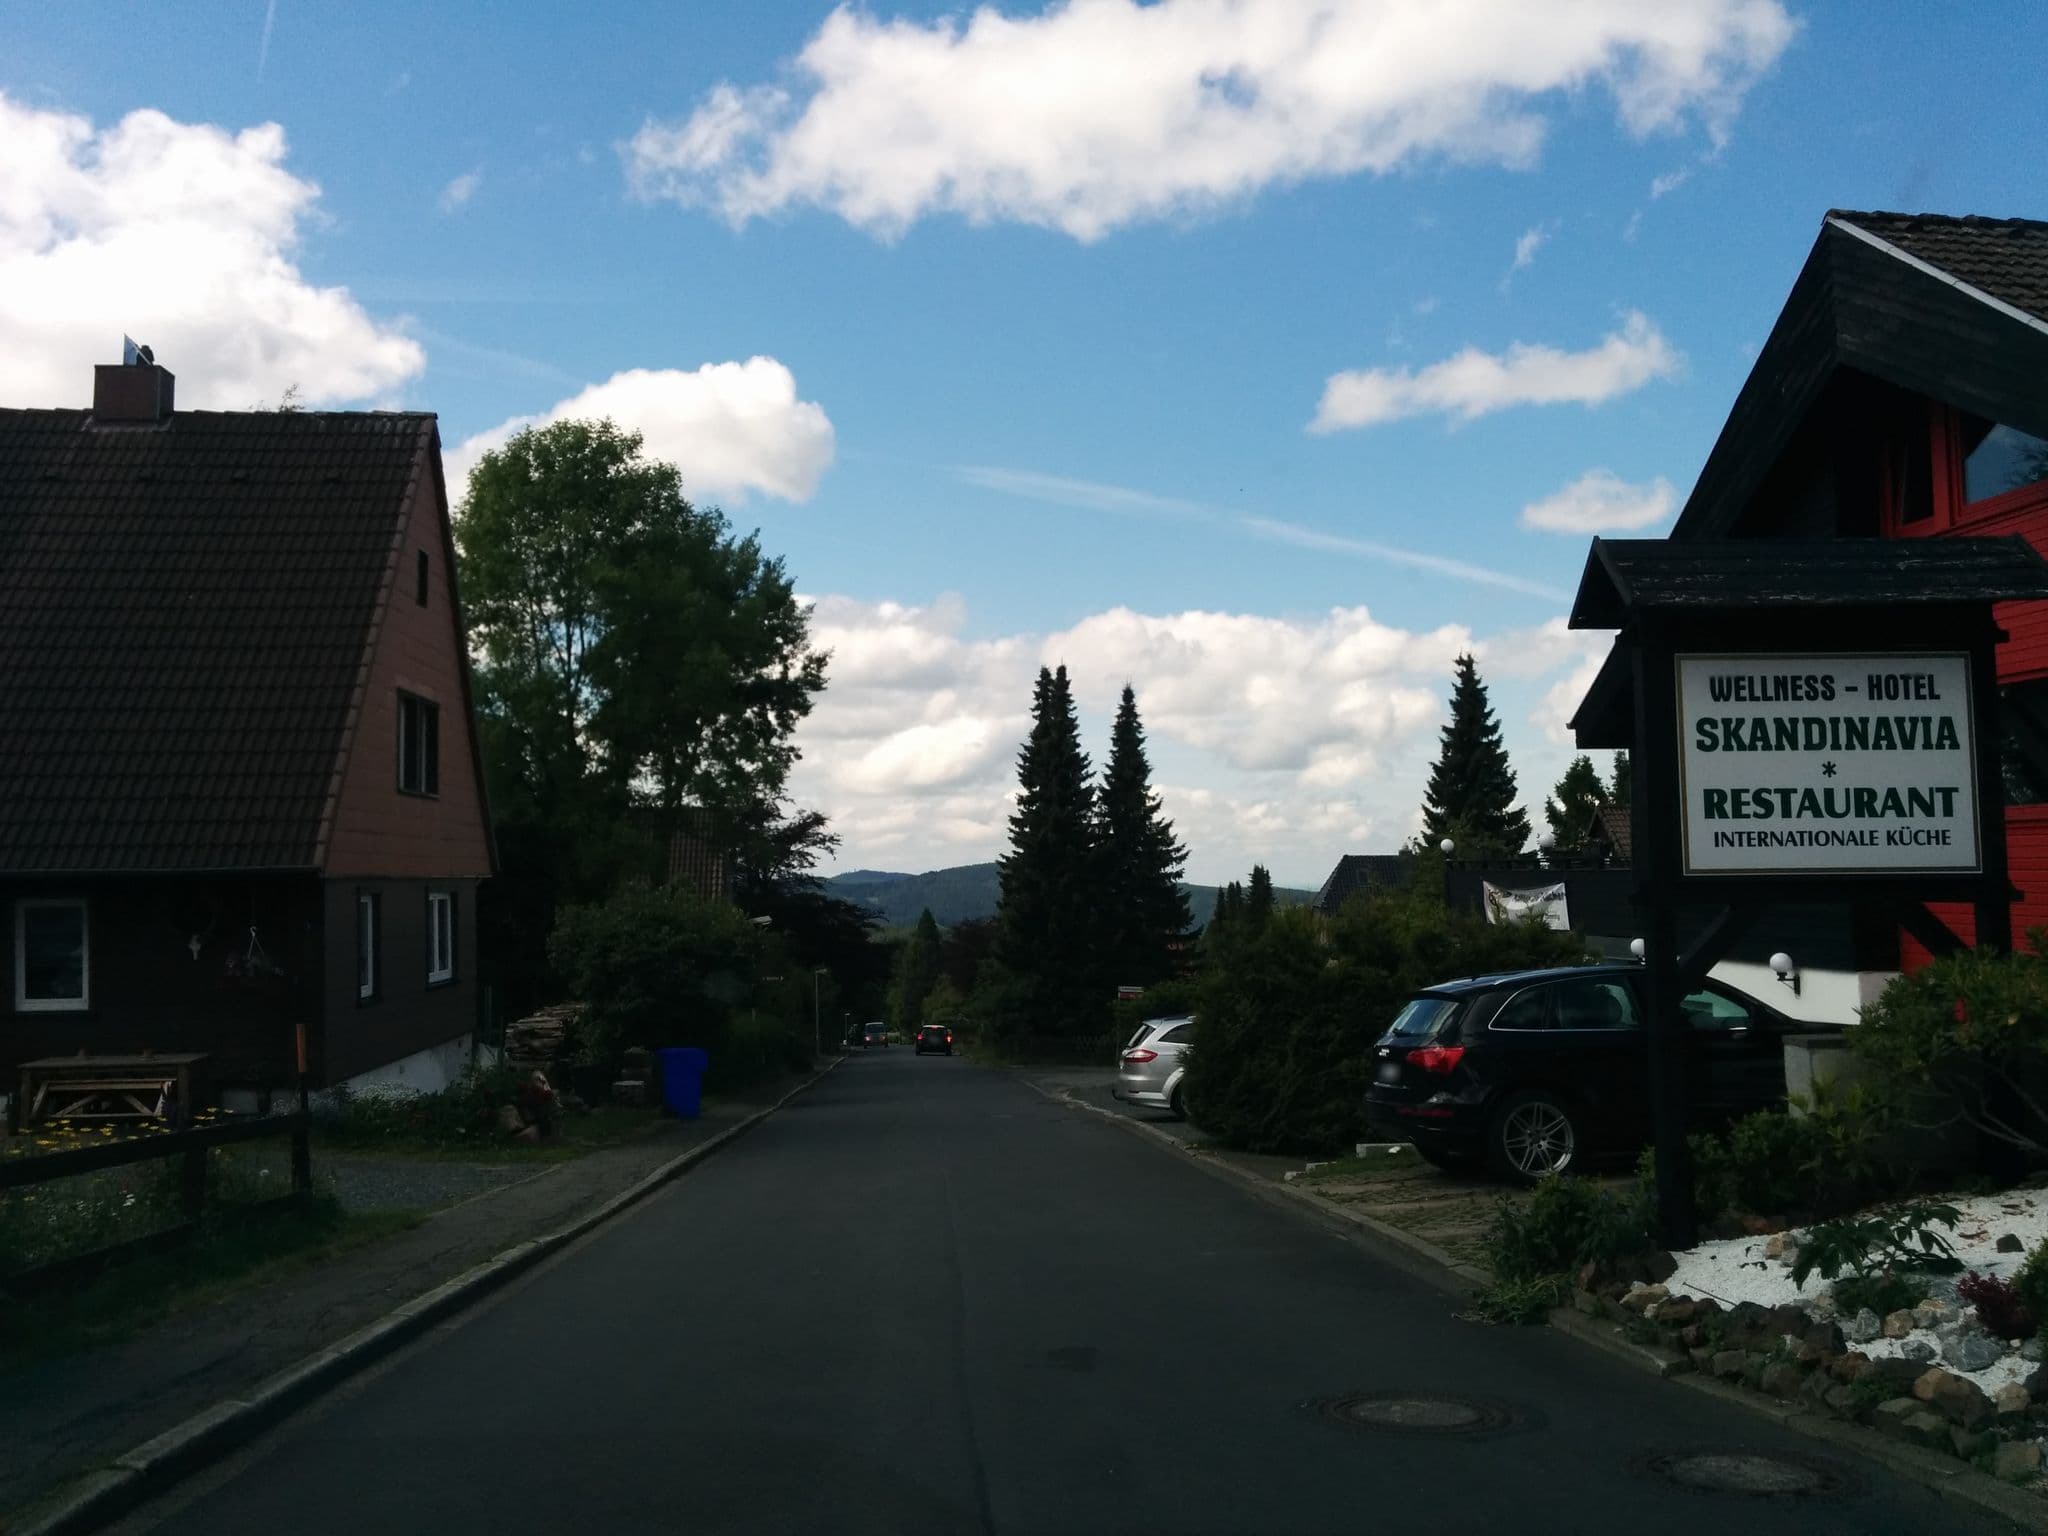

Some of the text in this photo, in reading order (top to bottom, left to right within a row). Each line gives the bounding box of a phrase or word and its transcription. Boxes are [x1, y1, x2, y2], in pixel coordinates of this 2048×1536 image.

[1710, 675, 1836, 702] WELLNESS
[1868, 674, 1940, 700] HOTEL
[1696, 716, 1960, 752] SKANDINAVIA
[1703, 787, 1959, 819] RESTAURANT
[1714, 827, 1952, 848] INTERNATIONALE KÜCHE
